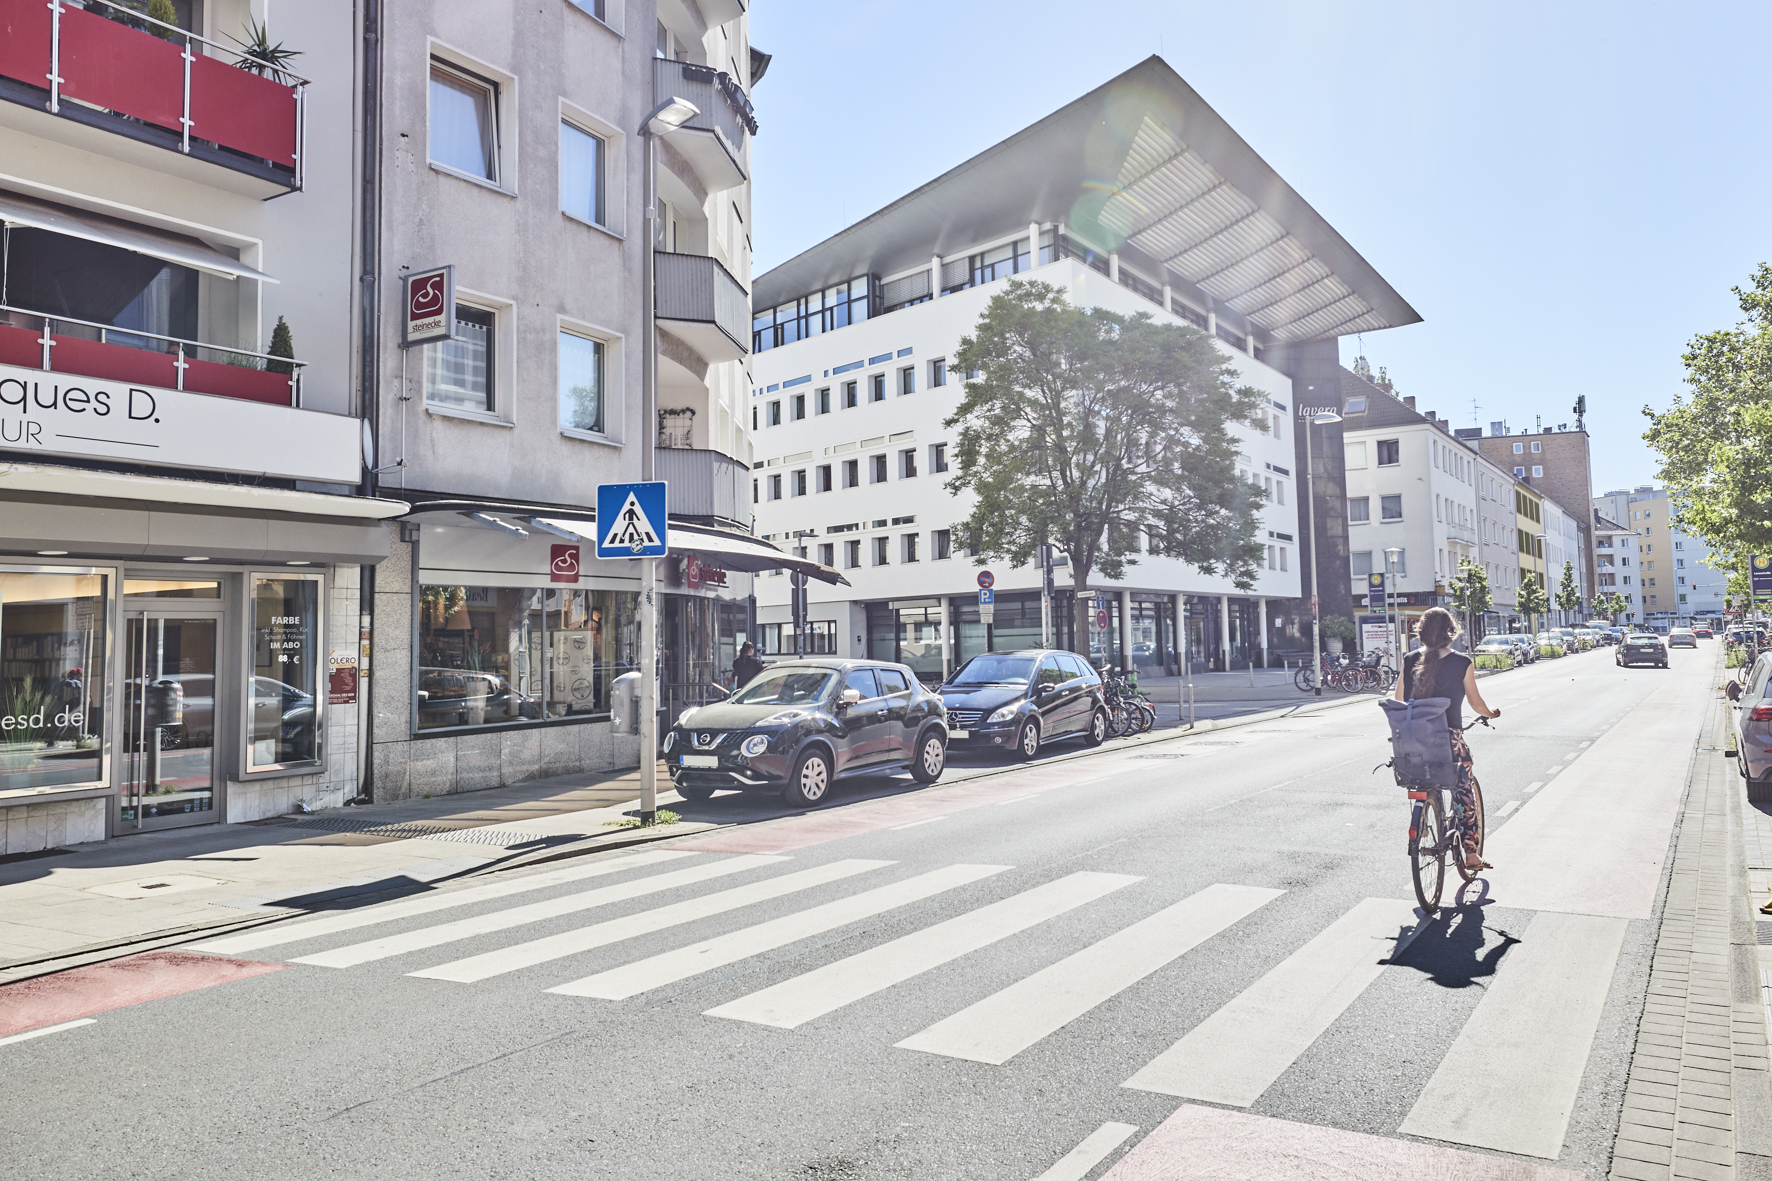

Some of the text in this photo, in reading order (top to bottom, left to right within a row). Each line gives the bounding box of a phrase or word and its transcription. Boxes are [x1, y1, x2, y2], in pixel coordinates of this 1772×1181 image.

[412, 318, 442, 332] steinecke
[0, 378, 160, 424] ques D.
[1298, 403, 1337, 416] lavera
[1, 418, 43, 445] UR
[981, 590, 990, 603] P
[271, 616, 300, 625] FARBE
[264, 633, 282, 641] Schnitt
[270, 641, 301, 649] IM ABO
[293, 655, 300, 664] €
[1, 704, 84, 730] esd.de
